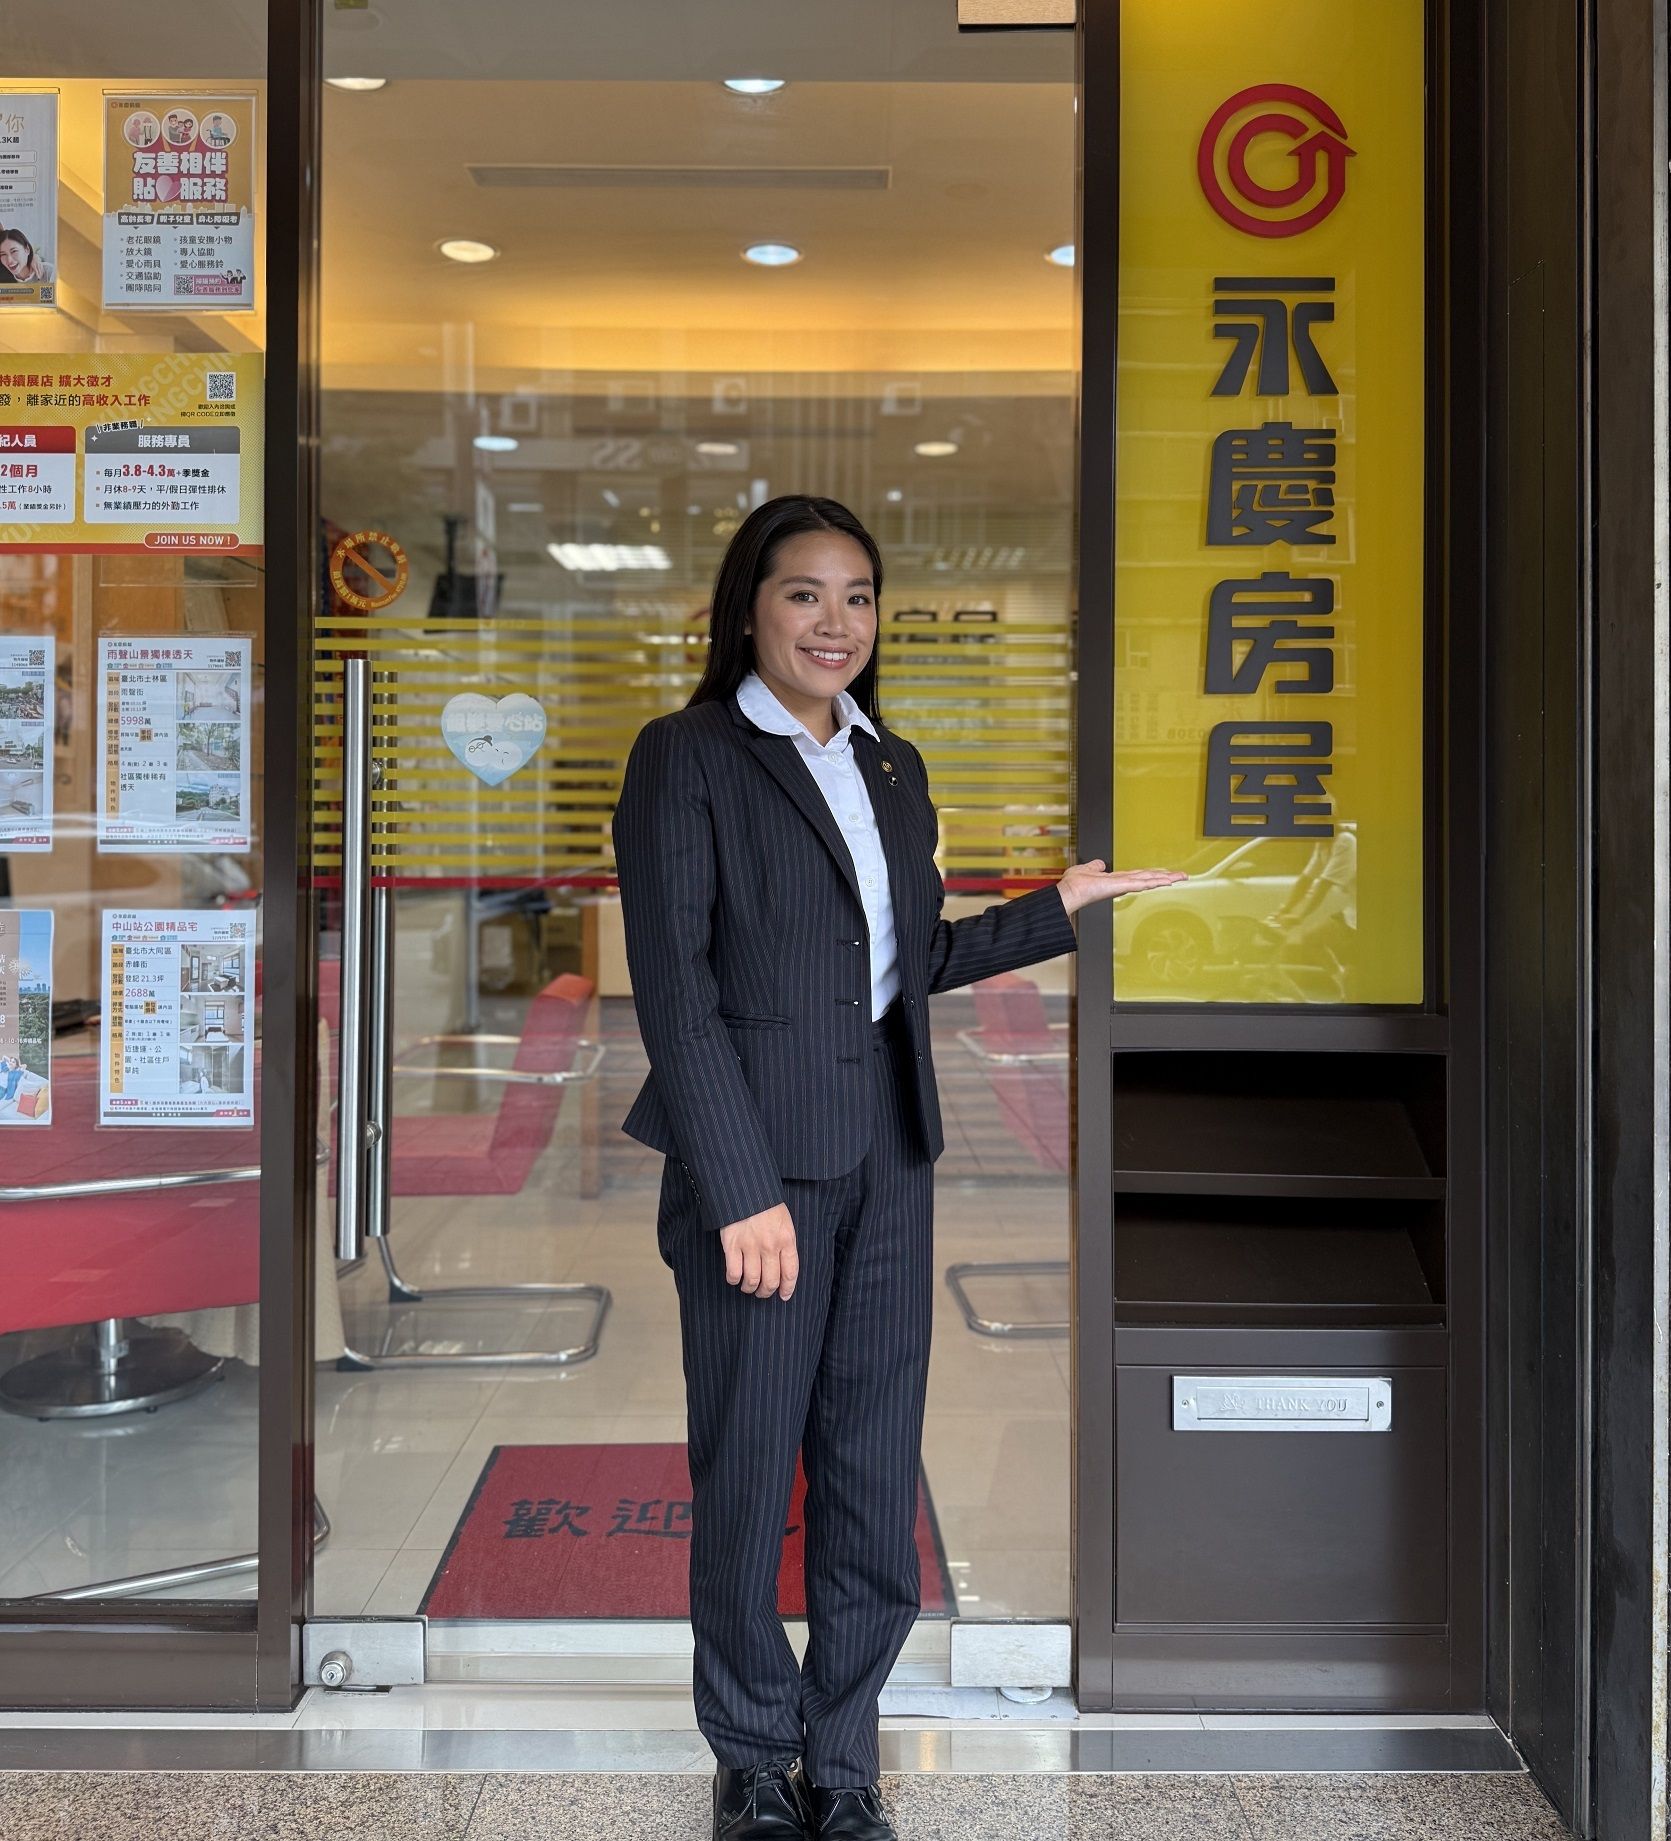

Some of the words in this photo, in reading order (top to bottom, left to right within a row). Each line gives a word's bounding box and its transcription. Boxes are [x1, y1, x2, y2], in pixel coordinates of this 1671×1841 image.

[0, 113, 25, 133] 你
[133, 151, 226, 174] 友善相伴
[126, 235, 161, 245] 老花眼鏡
[125, 248, 152, 256] 放大鏡
[179, 248, 215, 256] 專人協助
[125, 260, 161, 268] 愛心雨具
[180, 260, 224, 268] 愛心服務鈴
[125, 271, 161, 281] 交通協助
[0, 374, 54, 388] 持續展店
[59, 374, 113, 388] 擴大徵才
[0, 434, 37, 448] 紀人員
[138, 434, 190, 448] 服務專員
[104, 501, 200, 511] 無業績壓力的外勤工作
[154, 536, 179, 545] JOIN
[182, 536, 196, 545] US
[1202, 276, 1339, 838] 永慶房屋
[107, 649, 193, 660] 雨聲山景獨棟透天
[121, 716, 152, 726] 5998萬
[112, 921, 198, 932] 中山站公園精品宅
[125, 988, 155, 997] 2688萬
[1255, 1395, 1310, 1413] THANK
[1318, 1397, 1348, 1413] YOU
